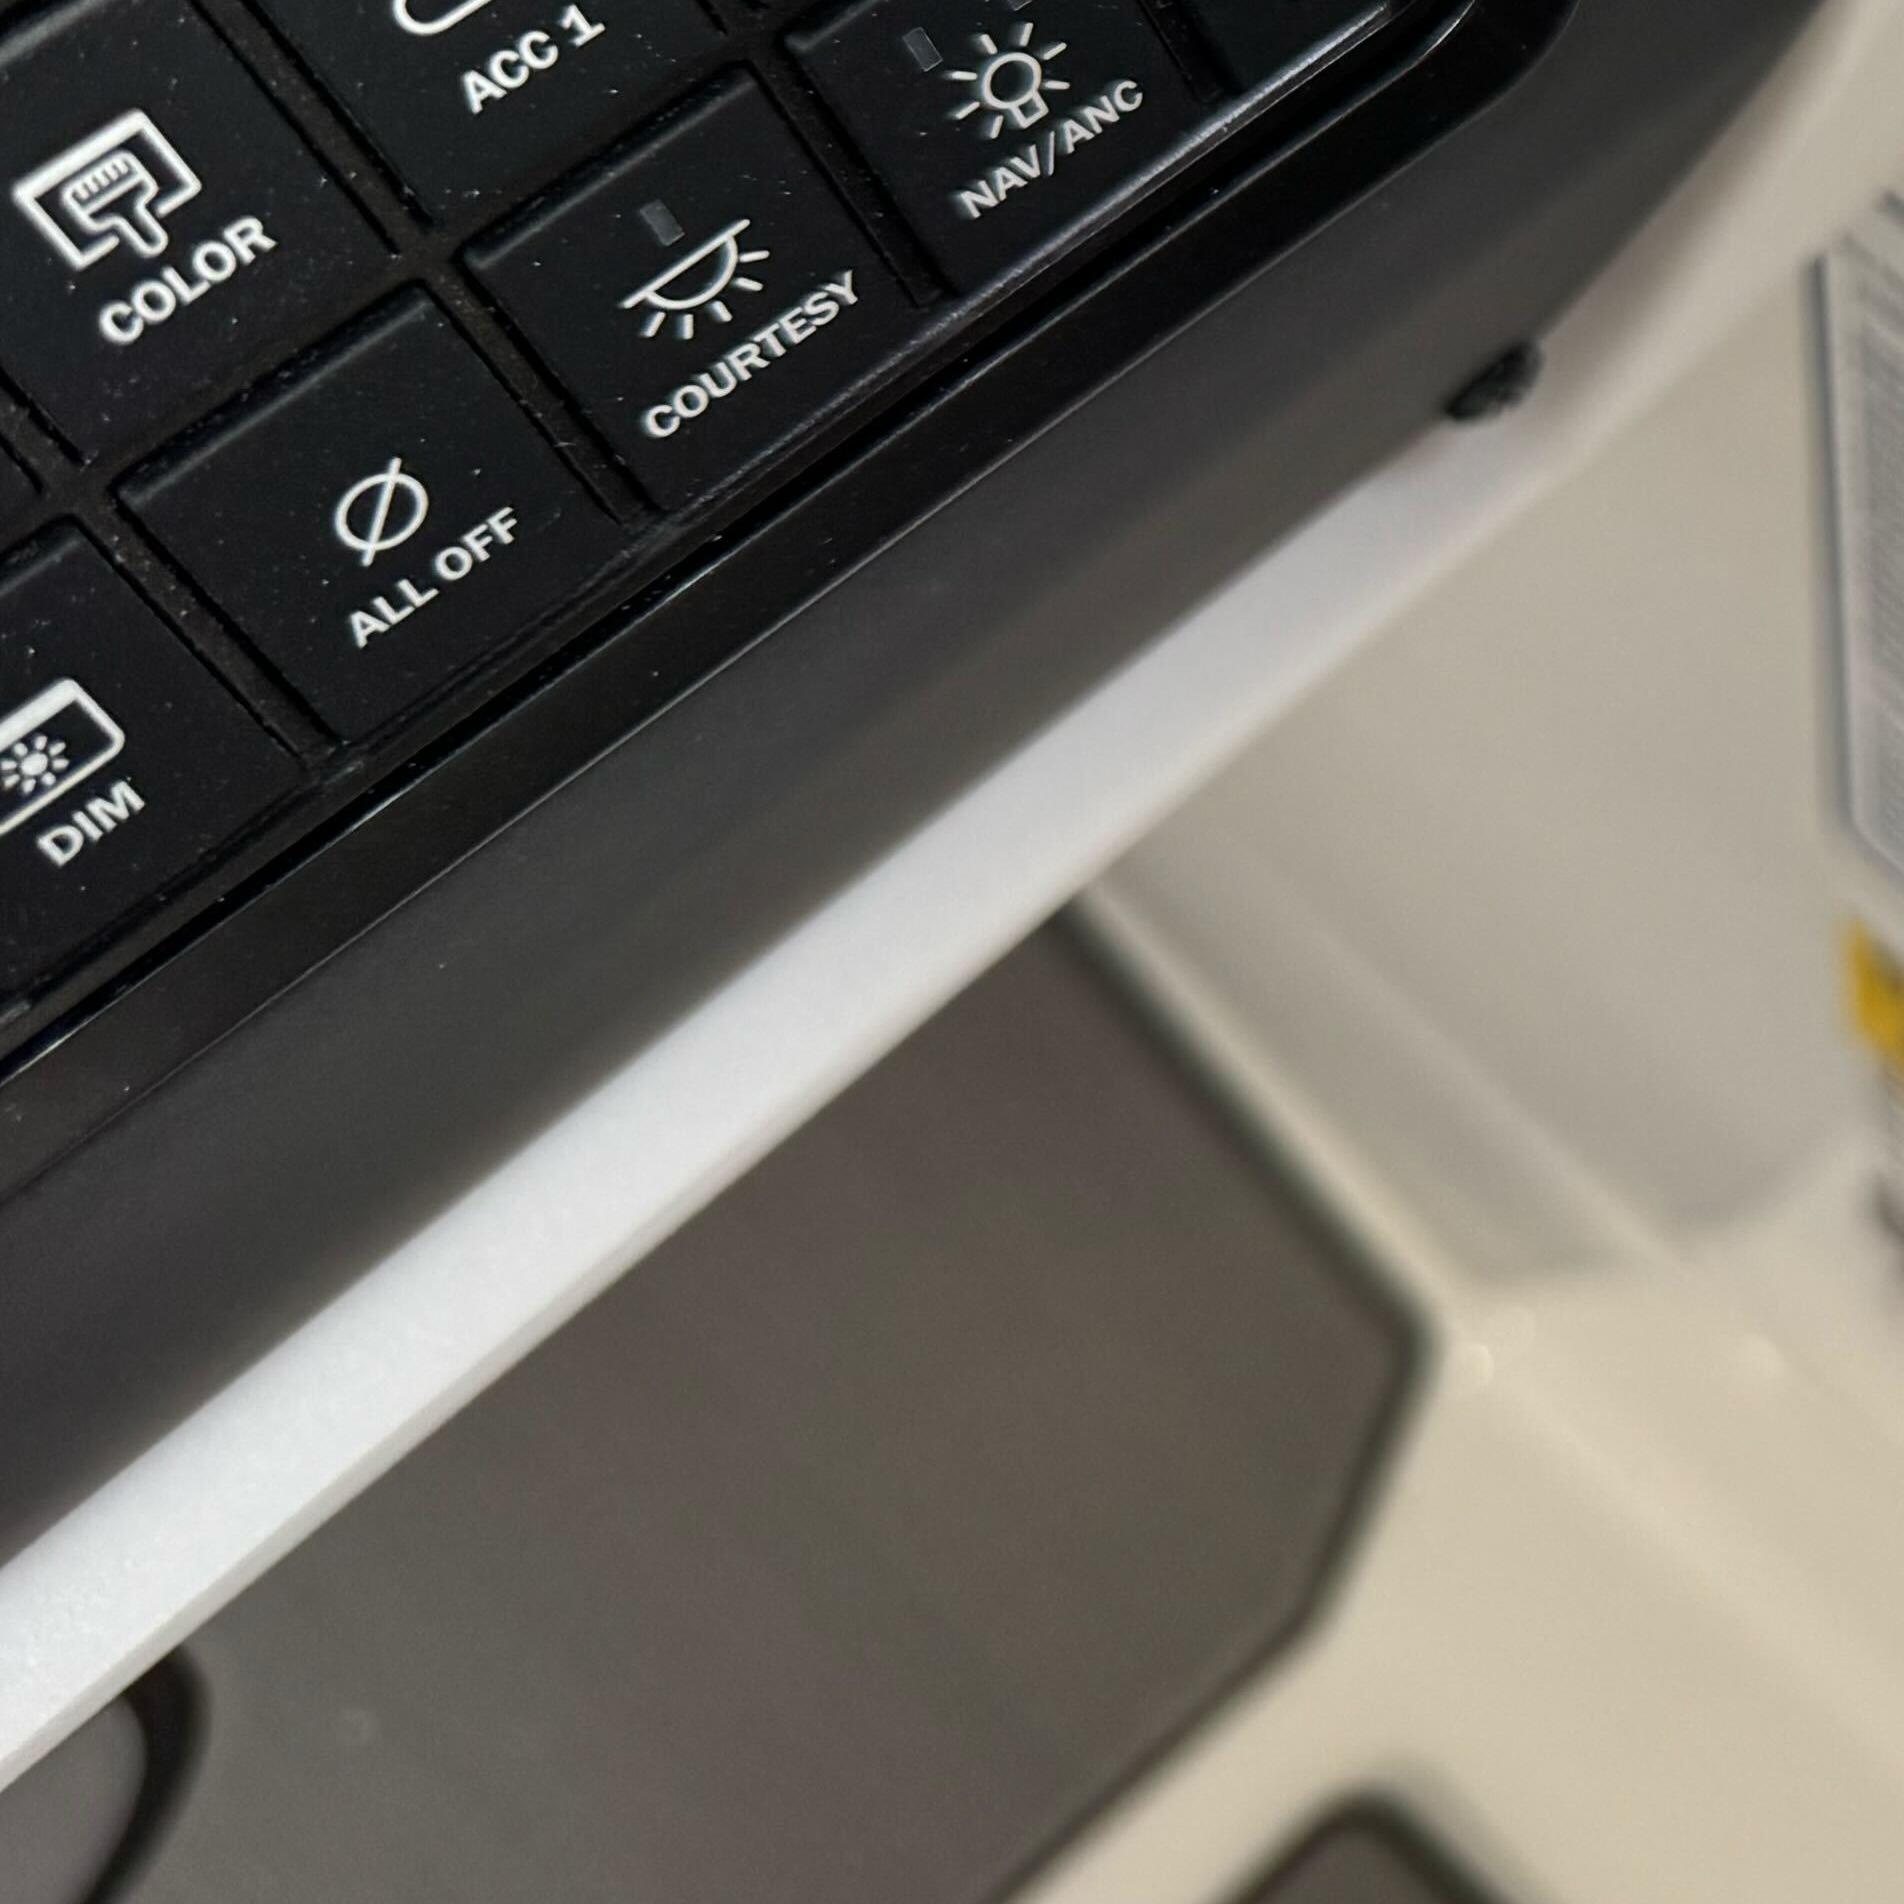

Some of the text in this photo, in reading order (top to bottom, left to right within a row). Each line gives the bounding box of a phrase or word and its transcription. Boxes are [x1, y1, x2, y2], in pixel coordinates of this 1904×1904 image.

[460, 3, 607, 114] ACC 1
[958, 79, 1143, 219] NAV/ANC
[98, 215, 278, 345] COLOR
[643, 270, 861, 441] COURTESY
[350, 506, 521, 648] ALL OFF
[36, 779, 147, 869] DIM
